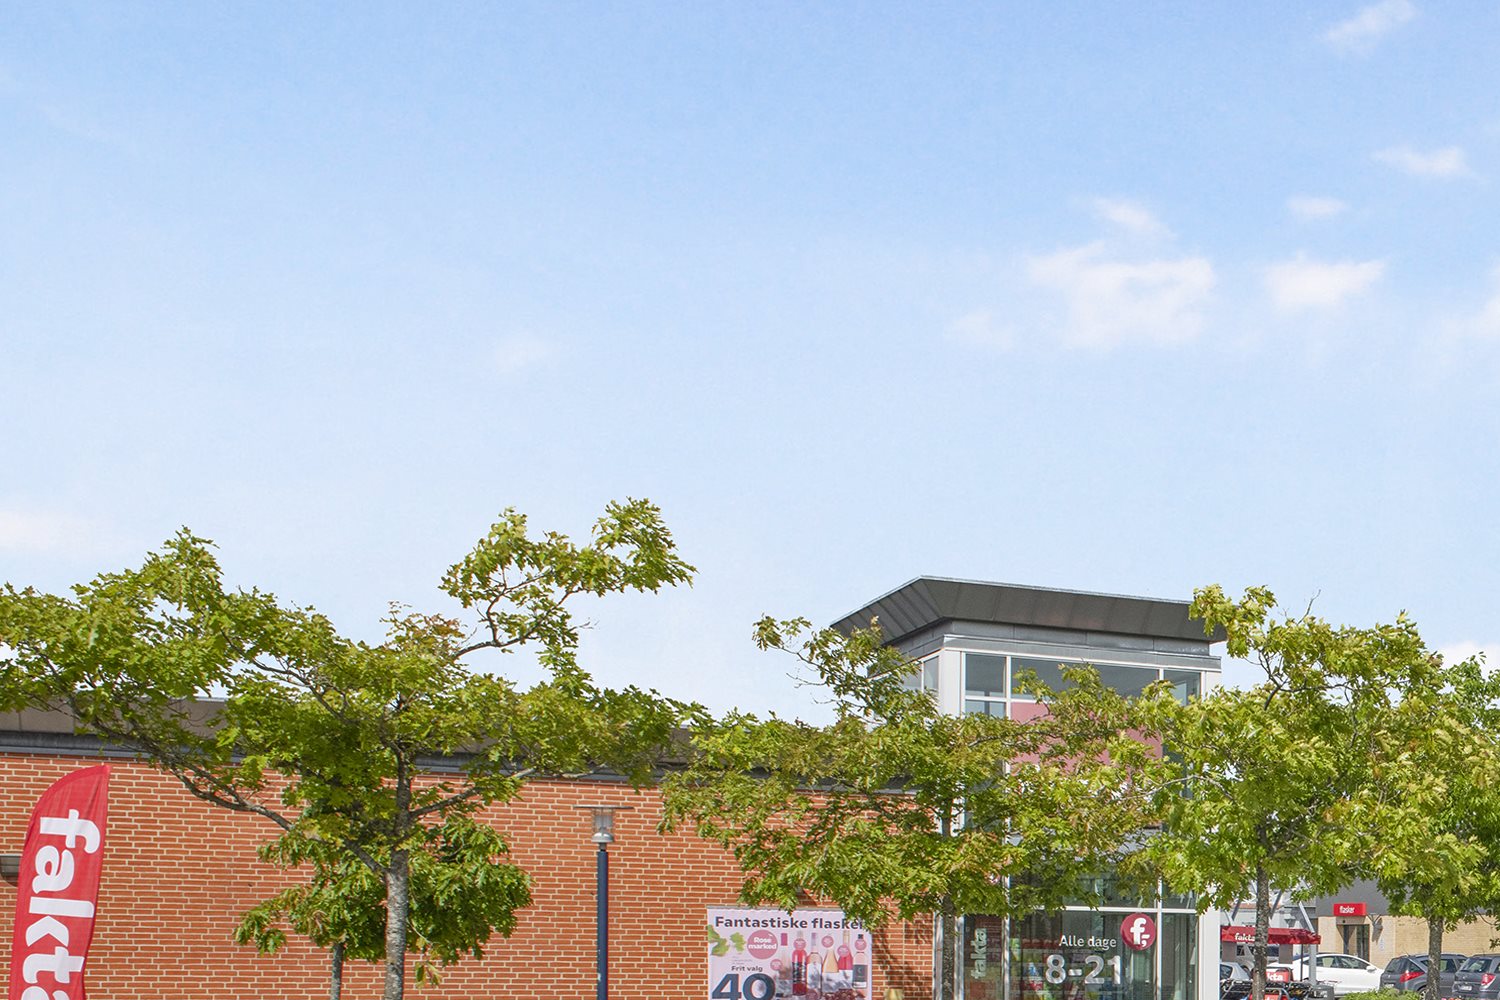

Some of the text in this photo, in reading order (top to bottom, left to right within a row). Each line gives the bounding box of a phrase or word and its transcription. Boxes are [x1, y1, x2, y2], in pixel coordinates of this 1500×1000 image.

[715, 916, 808, 929] Fantastiske
[1059, 935, 1117, 951] Alle dage
[1045, 954, 1121, 984] 8-21
